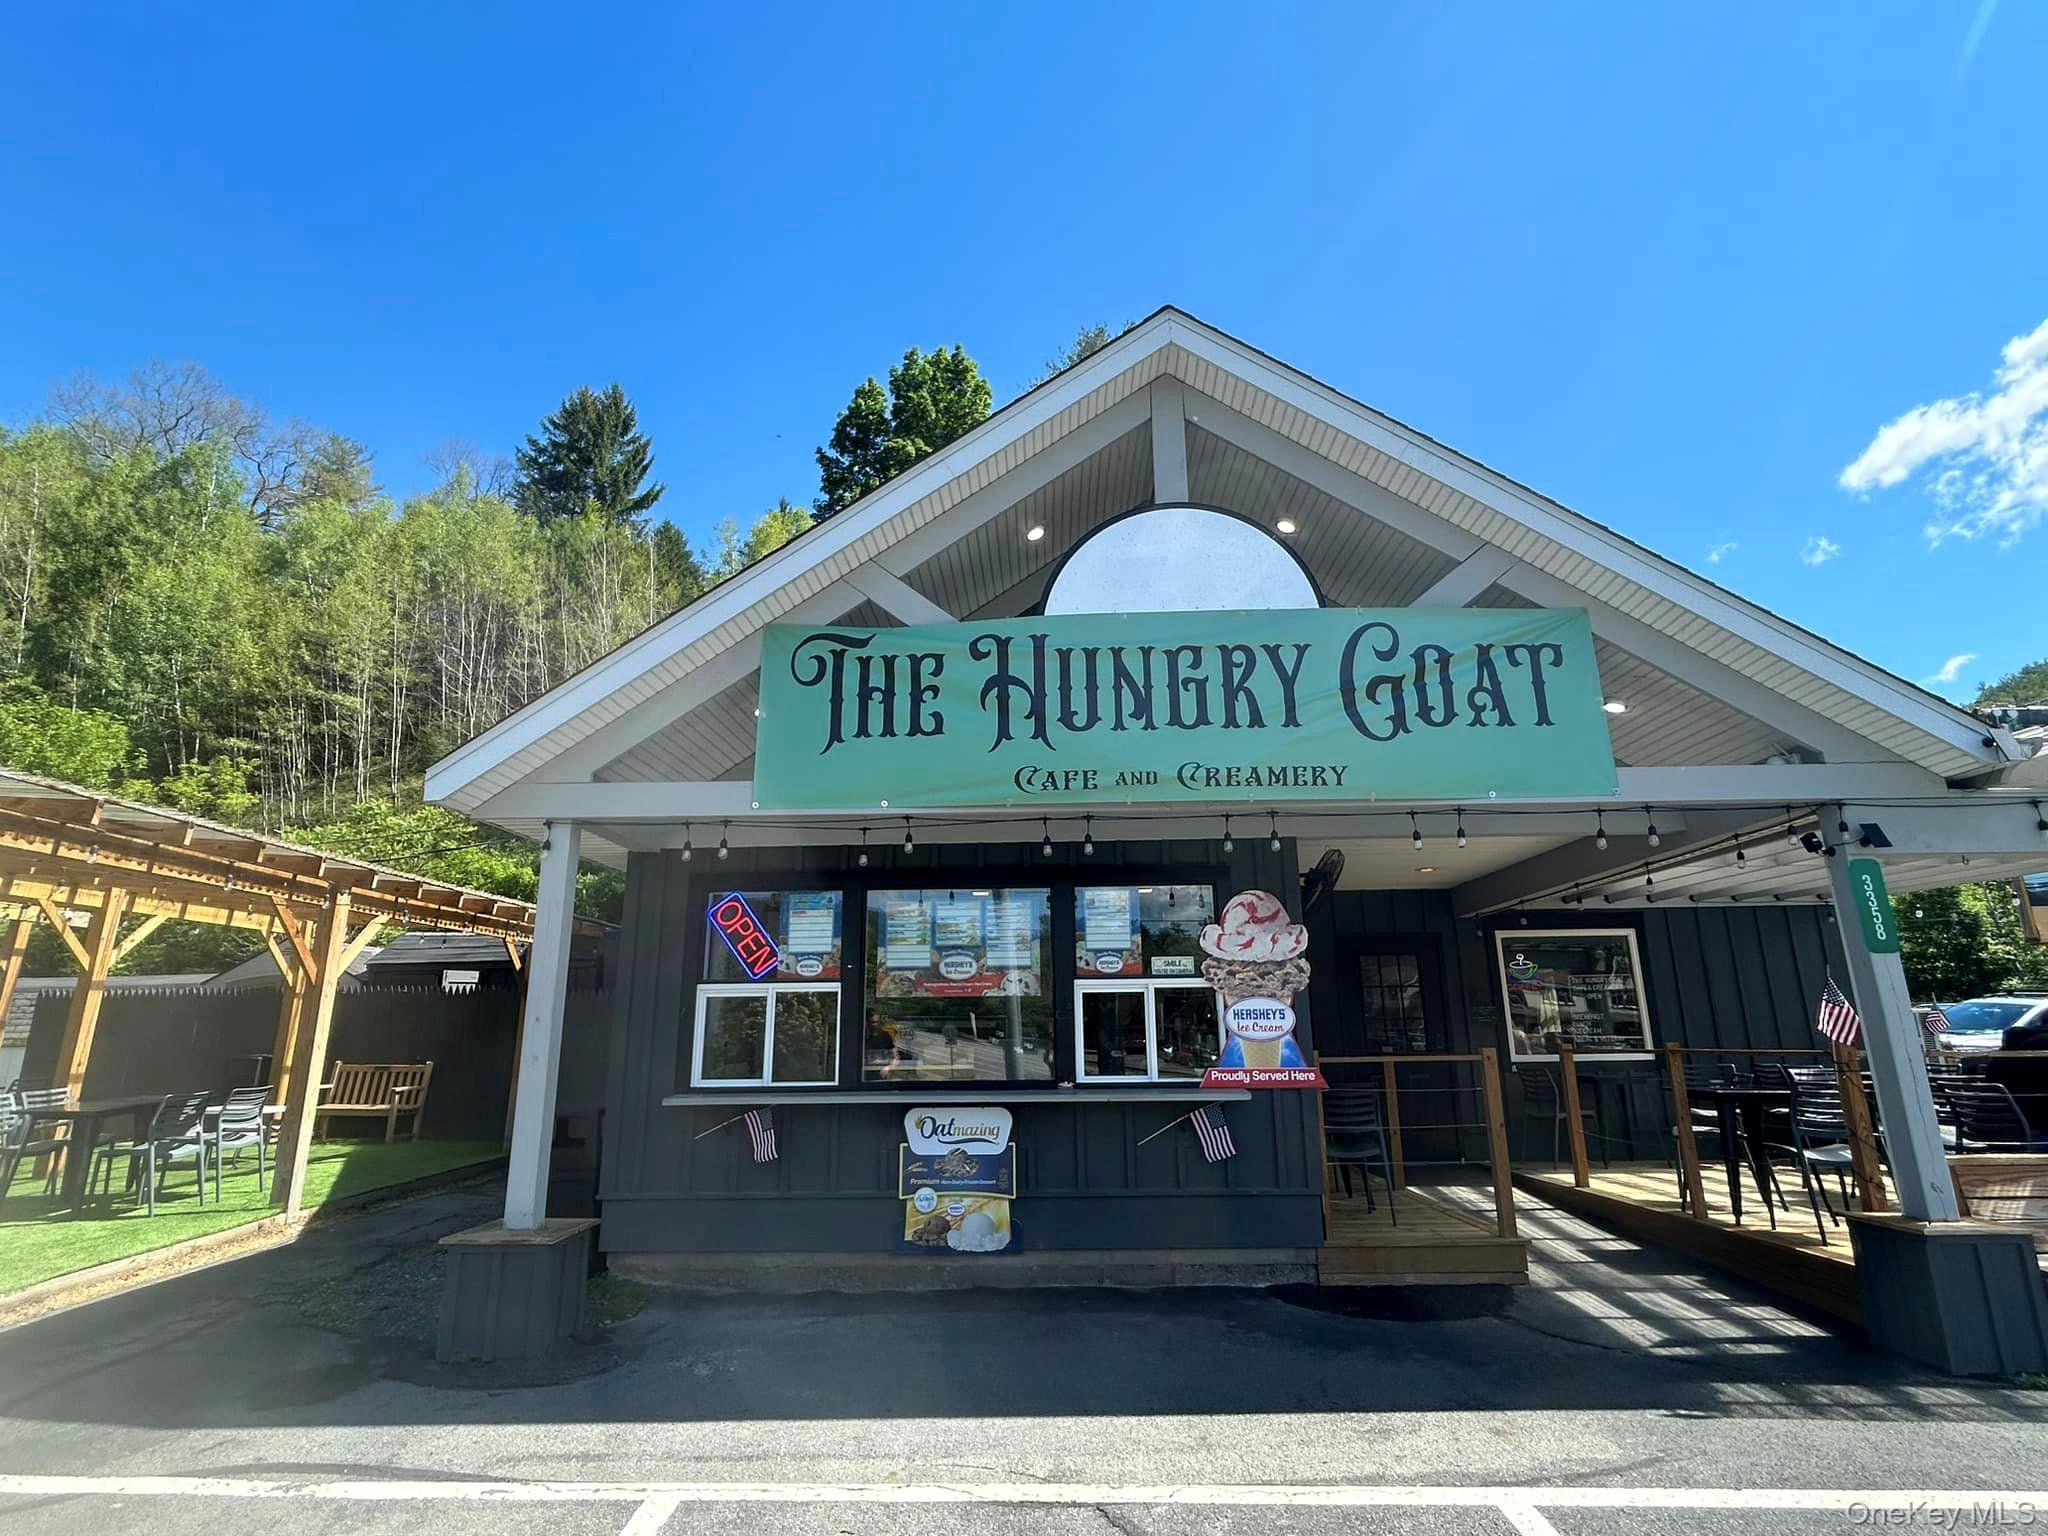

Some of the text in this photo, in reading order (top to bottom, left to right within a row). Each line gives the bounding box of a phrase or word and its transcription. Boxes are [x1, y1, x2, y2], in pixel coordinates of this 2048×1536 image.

[790, 621, 1564, 756] THE HUNGRY GOAT
[1013, 761, 1349, 795] CAFE AND CREAMERY
[1861, 874, 1887, 940] 3358
[717, 901, 777, 973] OPEN
[1233, 1008, 1286, 1020] HERSHEY'S
[1237, 1022, 1284, 1032] Ice Cream
[1211, 1070, 1316, 1083] Proudly Served Here
[920, 1116, 1001, 1140] Oatmazing
